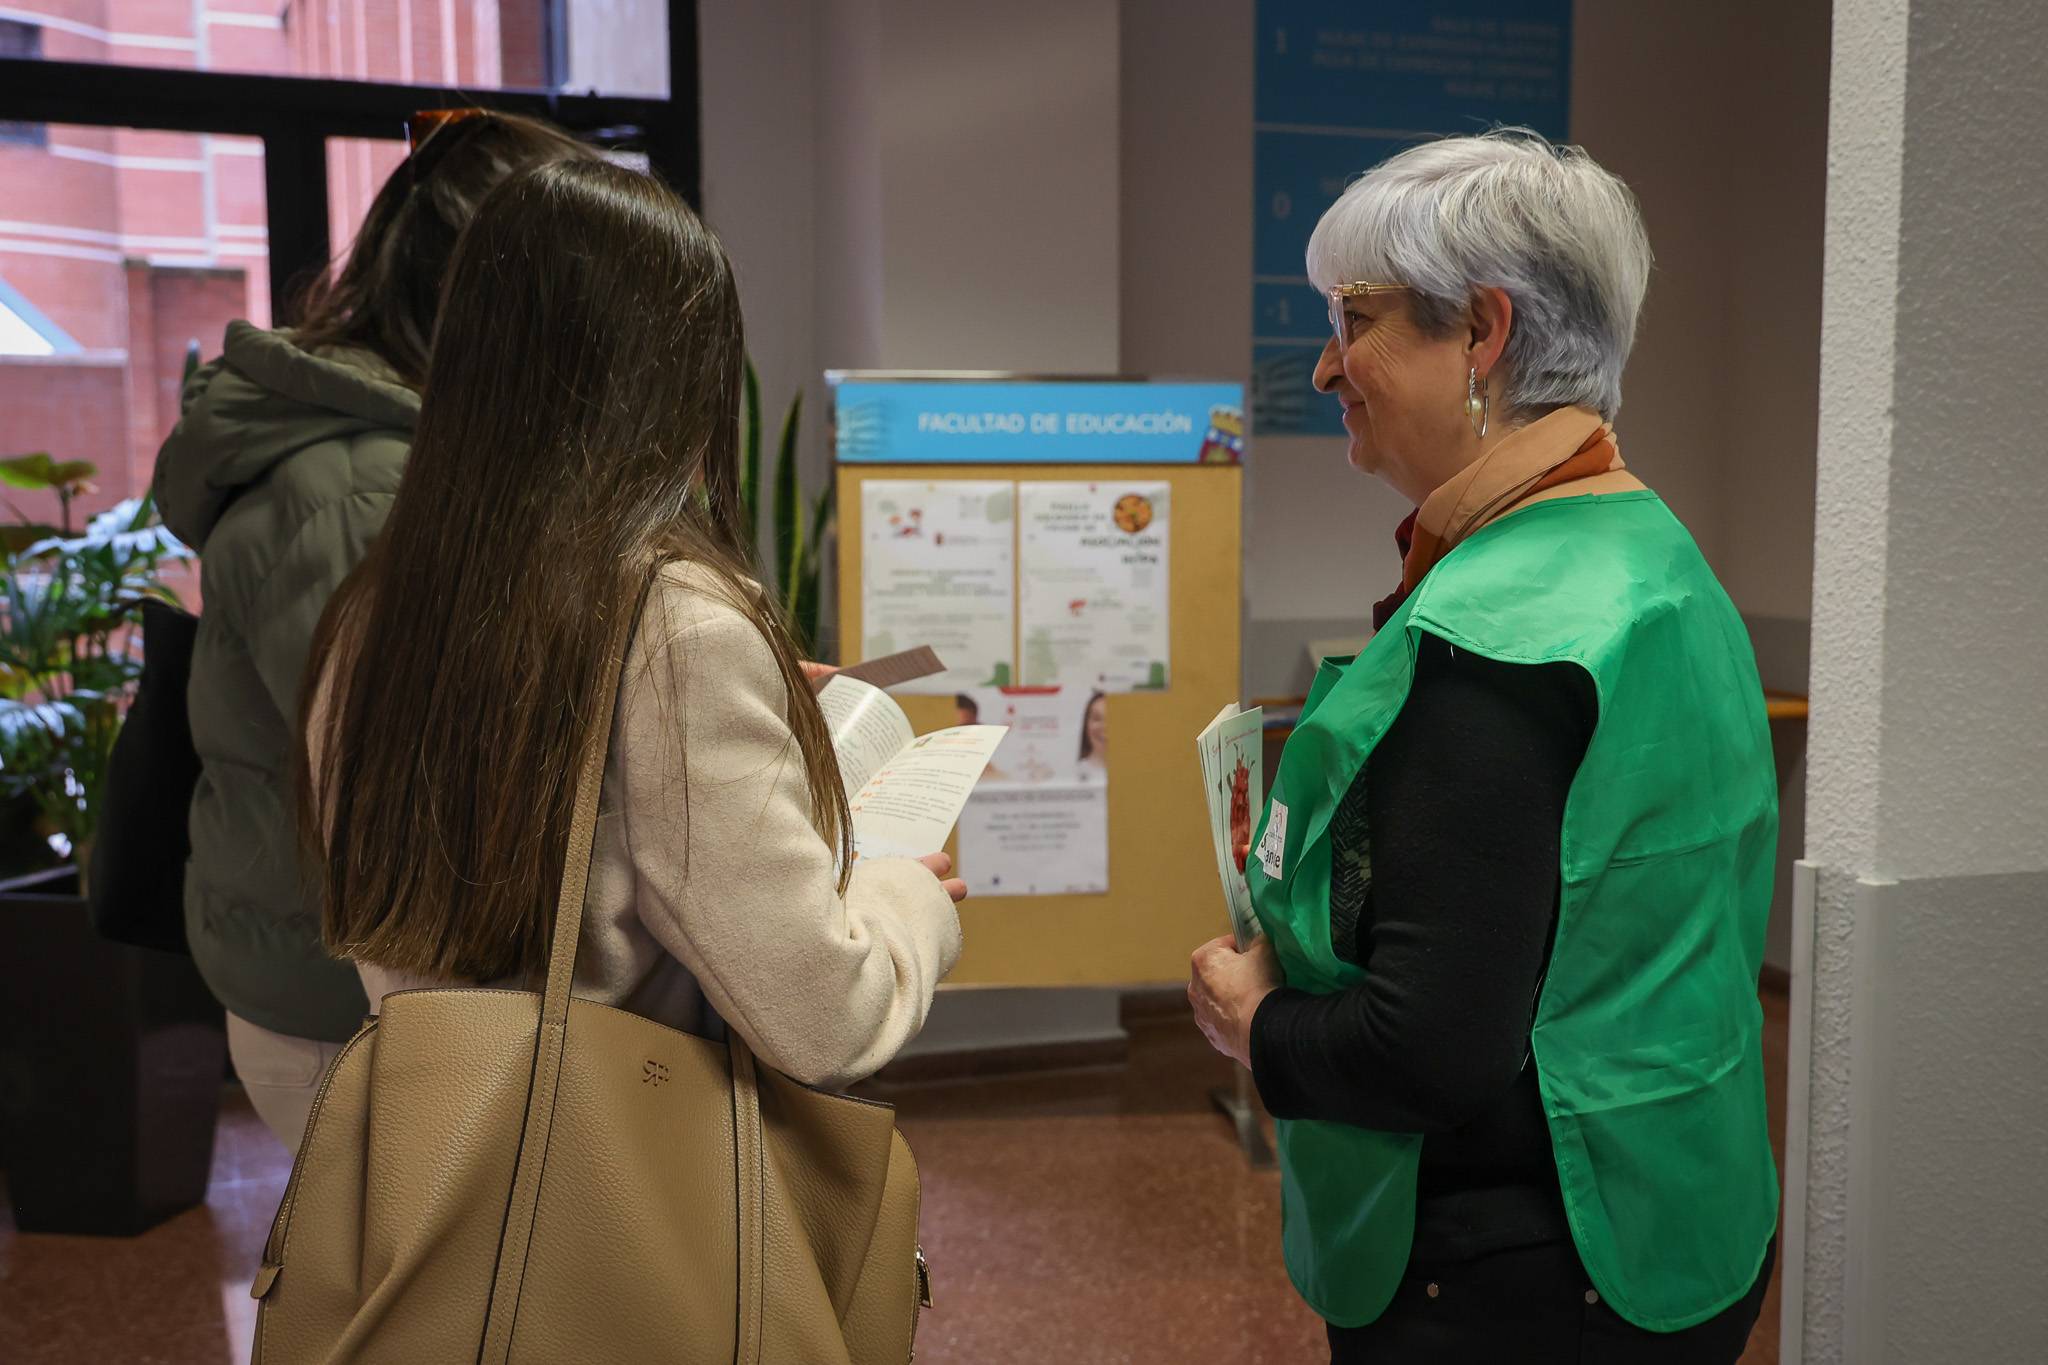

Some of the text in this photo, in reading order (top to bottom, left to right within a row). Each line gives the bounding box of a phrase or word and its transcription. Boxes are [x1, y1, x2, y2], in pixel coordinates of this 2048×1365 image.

[918, 408, 1192, 434] FACULTAD DE EDUCACIÓN
